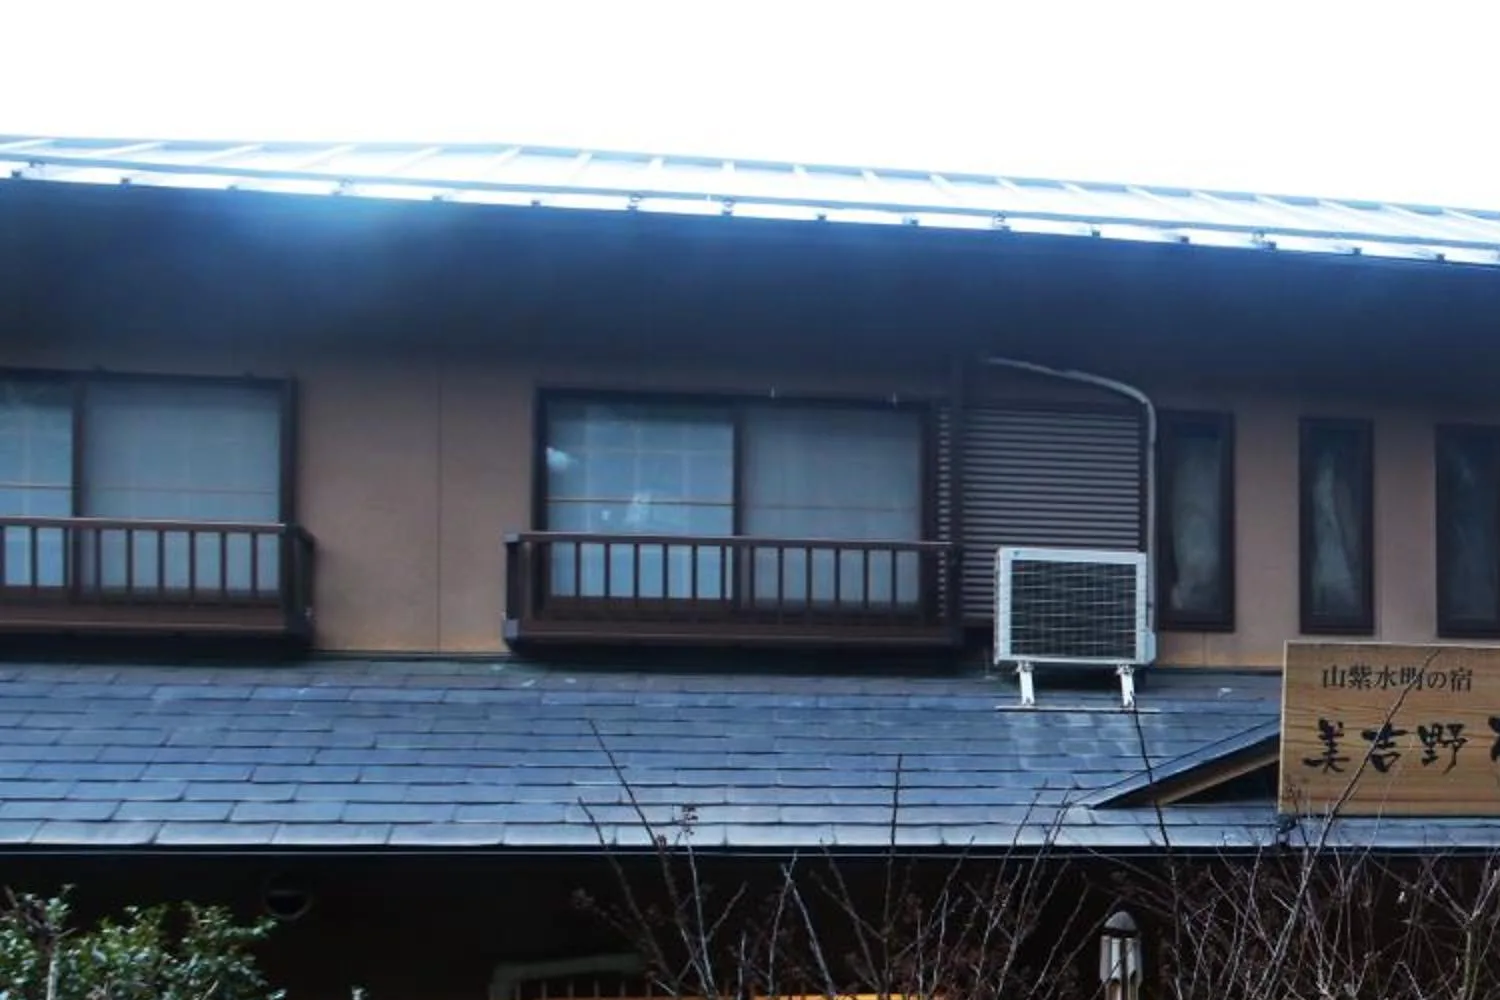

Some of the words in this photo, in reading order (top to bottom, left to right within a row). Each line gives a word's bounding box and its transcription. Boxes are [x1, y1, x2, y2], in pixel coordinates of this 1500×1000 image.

[1322, 664, 1473, 692] 山紫水明の宿
